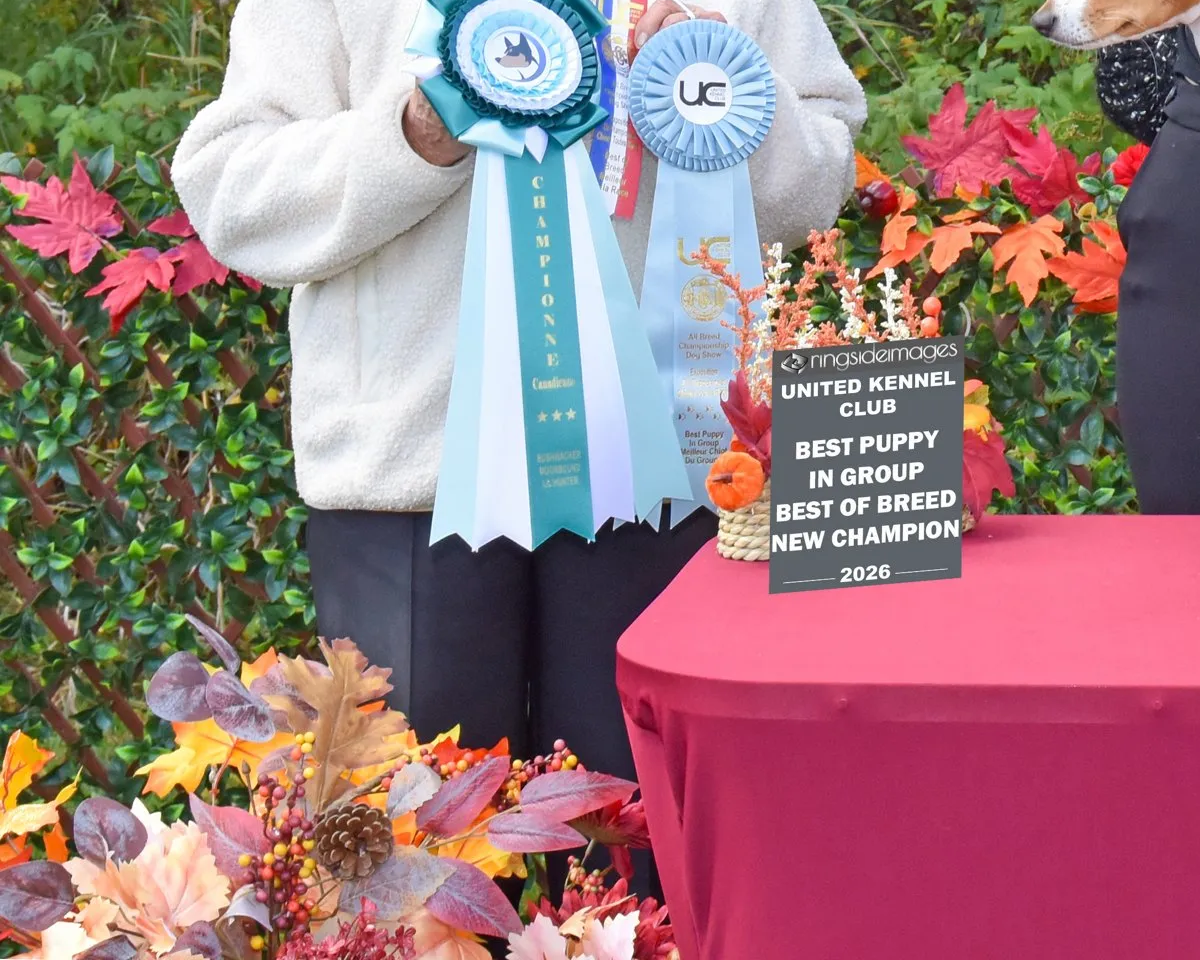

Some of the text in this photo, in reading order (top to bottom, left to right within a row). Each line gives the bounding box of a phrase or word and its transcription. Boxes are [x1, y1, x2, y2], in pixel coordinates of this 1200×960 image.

[532, 175, 559, 367] CHAMPIONNE
[679, 342, 730, 350] Championship
[811, 342, 958, 372] ringsideimages
[781, 371, 956, 399] UNITED KENNEL
[839, 398, 897, 417] CLUB
[685, 430, 724, 439] Best Puppy
[698, 439, 719, 448] Group
[795, 430, 939, 460] BEST PUPPY
[681, 447, 707, 456] Meilleur
[809, 462, 925, 489] IN GROUP
[776, 489, 957, 522] BEST OF BREED
[772, 519, 960, 553] NEW CHAMPION
[840, 564, 891, 583] 2026
